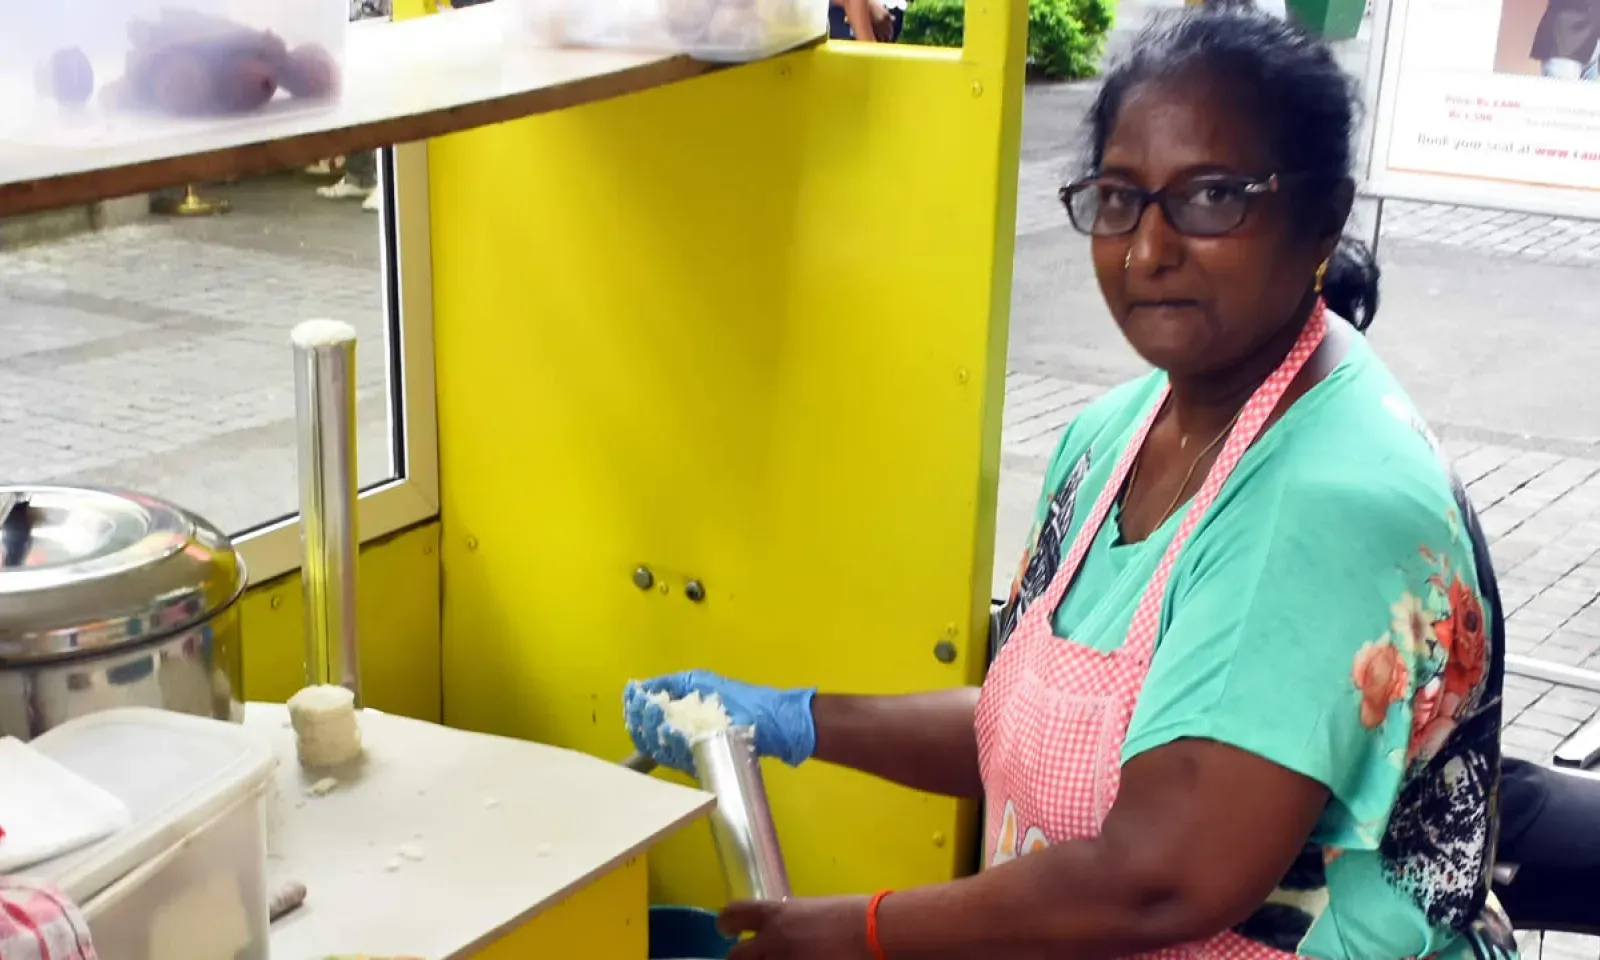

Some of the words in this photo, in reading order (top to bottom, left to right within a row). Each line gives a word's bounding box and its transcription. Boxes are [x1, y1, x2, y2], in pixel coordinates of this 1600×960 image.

[1417, 132, 1449, 146] Book
[1453, 138, 1482, 150] your
[1487, 141, 1514, 153] seat
[1518, 144, 1531, 154] at
